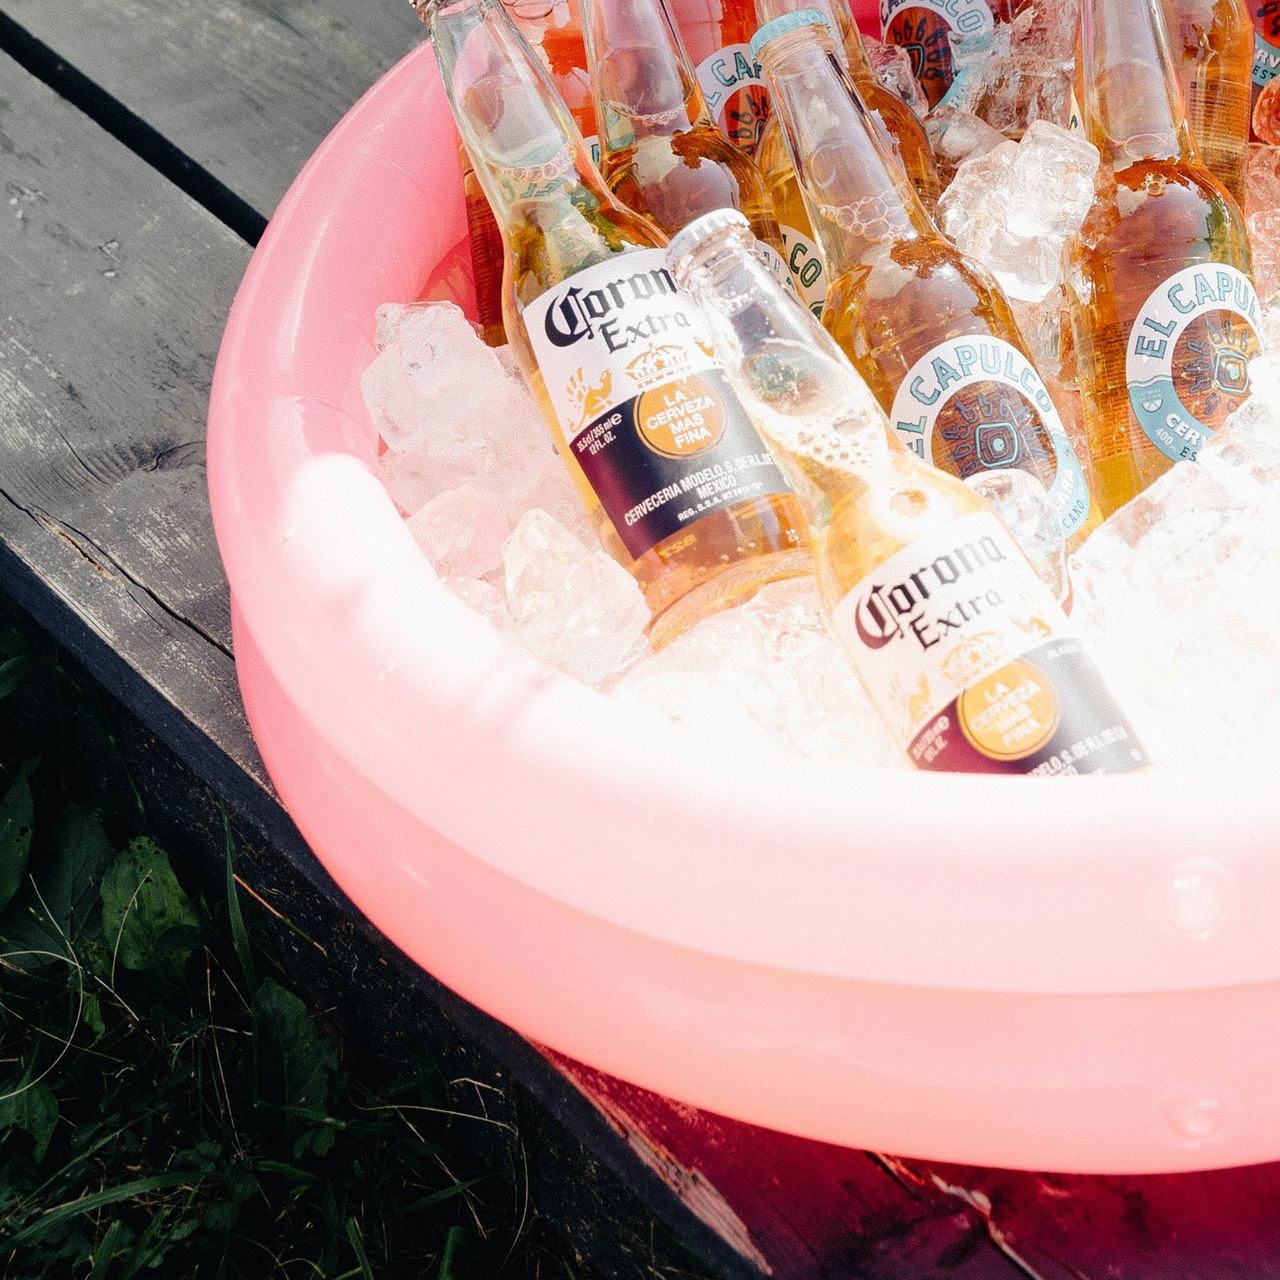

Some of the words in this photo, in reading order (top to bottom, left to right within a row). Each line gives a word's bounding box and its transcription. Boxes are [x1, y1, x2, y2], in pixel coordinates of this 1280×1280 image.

[544, 267, 678, 348] Coron
[598, 309, 691, 355] Extra
[1134, 317, 1178, 360] EL
[663, 390, 688, 407] LA
[909, 342, 1051, 413] CAPULCO
[645, 395, 716, 431] CERVEZA
[669, 412, 706, 436] MAS
[673, 426, 713, 449] FINA
[624, 482, 683, 527] CERVECERIA
[696, 474, 737, 500] MEXICO
[854, 535, 1007, 650] Corona
[908, 589, 1005, 652] Extra
